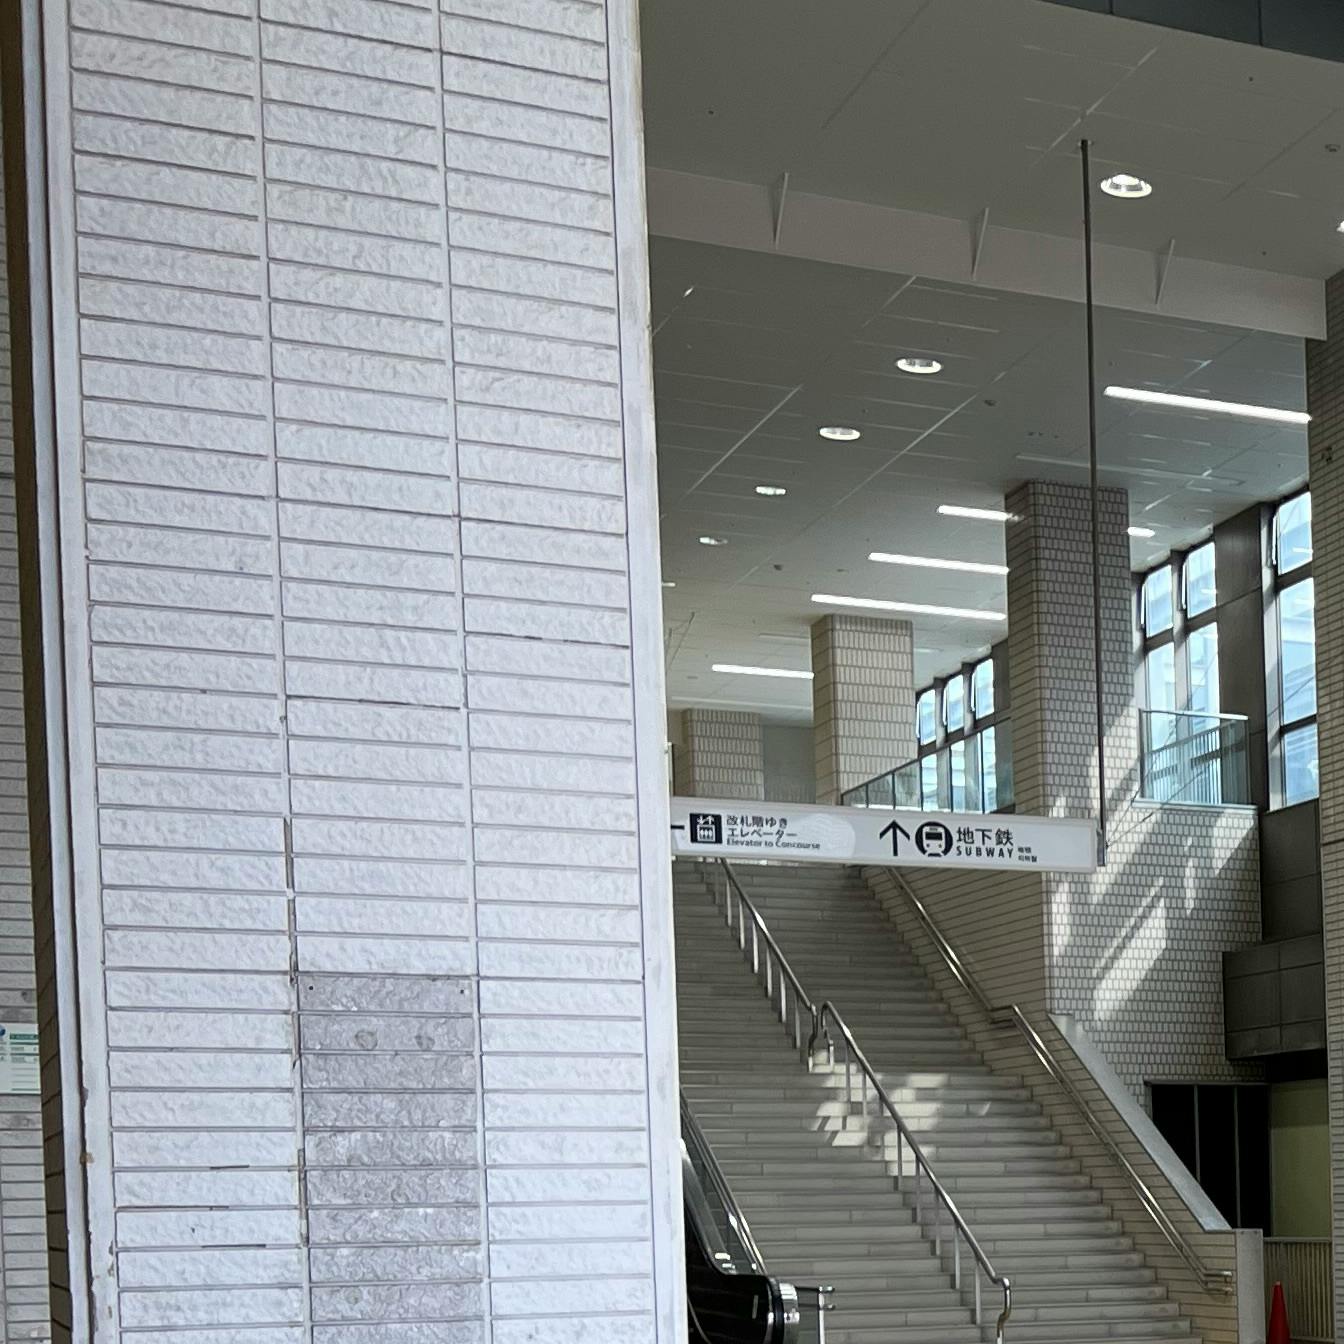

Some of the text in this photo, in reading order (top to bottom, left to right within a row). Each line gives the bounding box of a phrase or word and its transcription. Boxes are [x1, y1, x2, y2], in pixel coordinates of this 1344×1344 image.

[727, 815, 787, 829] 改札階ゆき
[728, 828, 797, 840] エレベーター
[957, 826, 1014, 846] 地下鉄
[727, 838, 762, 847] Elevator
[776, 840, 820, 849] Concourse
[957, 845, 1014, 858] SUBWAY
